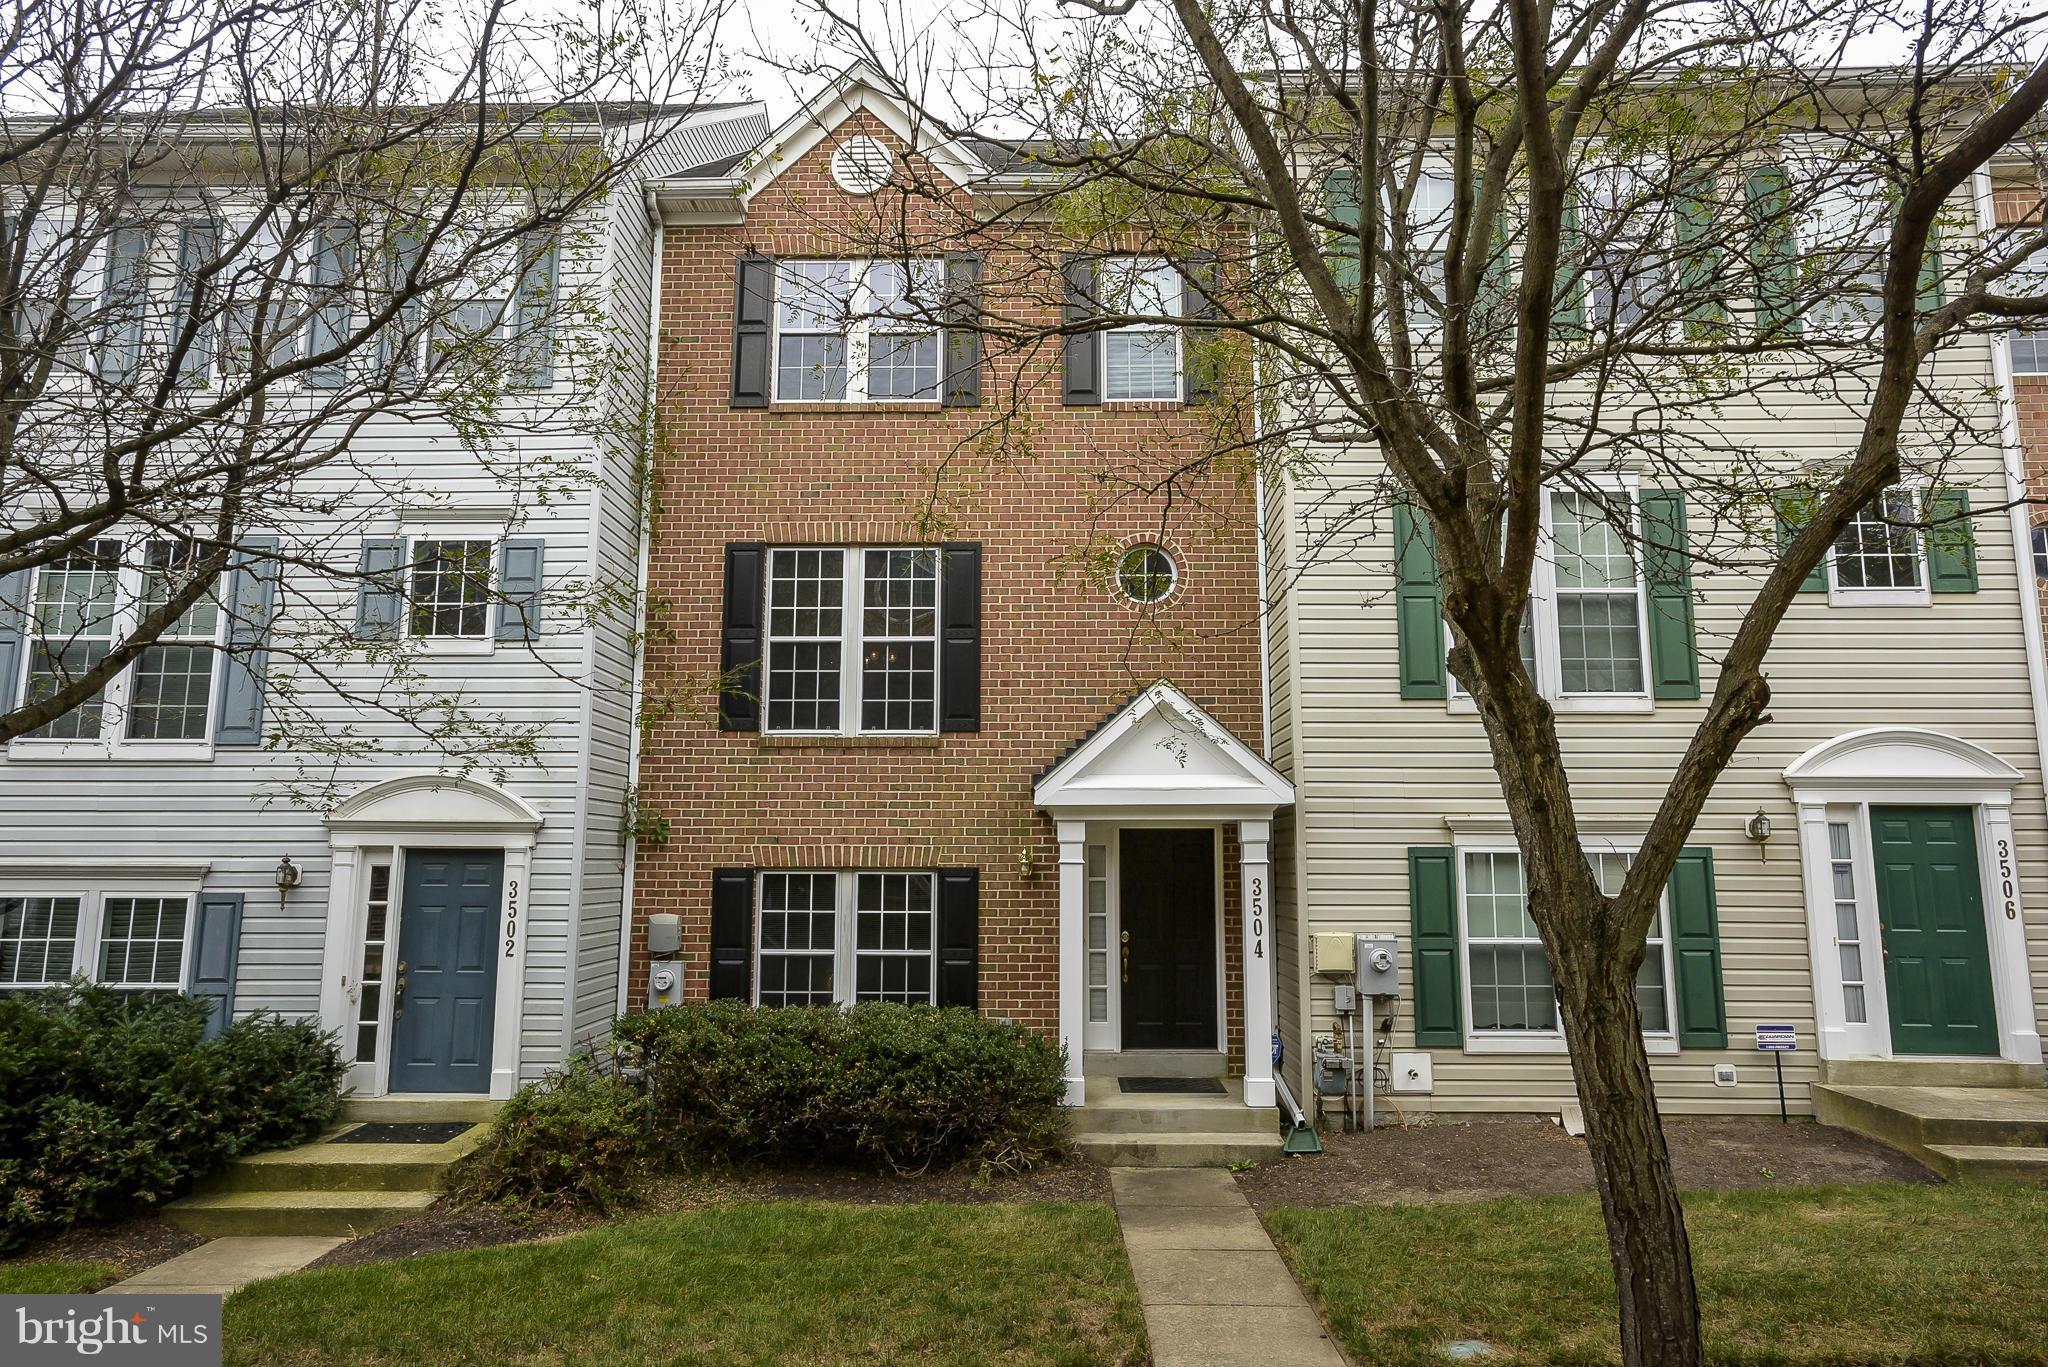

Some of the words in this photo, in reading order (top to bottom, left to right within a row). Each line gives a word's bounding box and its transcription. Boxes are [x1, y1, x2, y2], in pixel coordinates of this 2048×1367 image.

[505, 880, 518, 957] 3502
[1252, 877, 1264, 958] 3504
[1997, 839, 2016, 920] 3506
